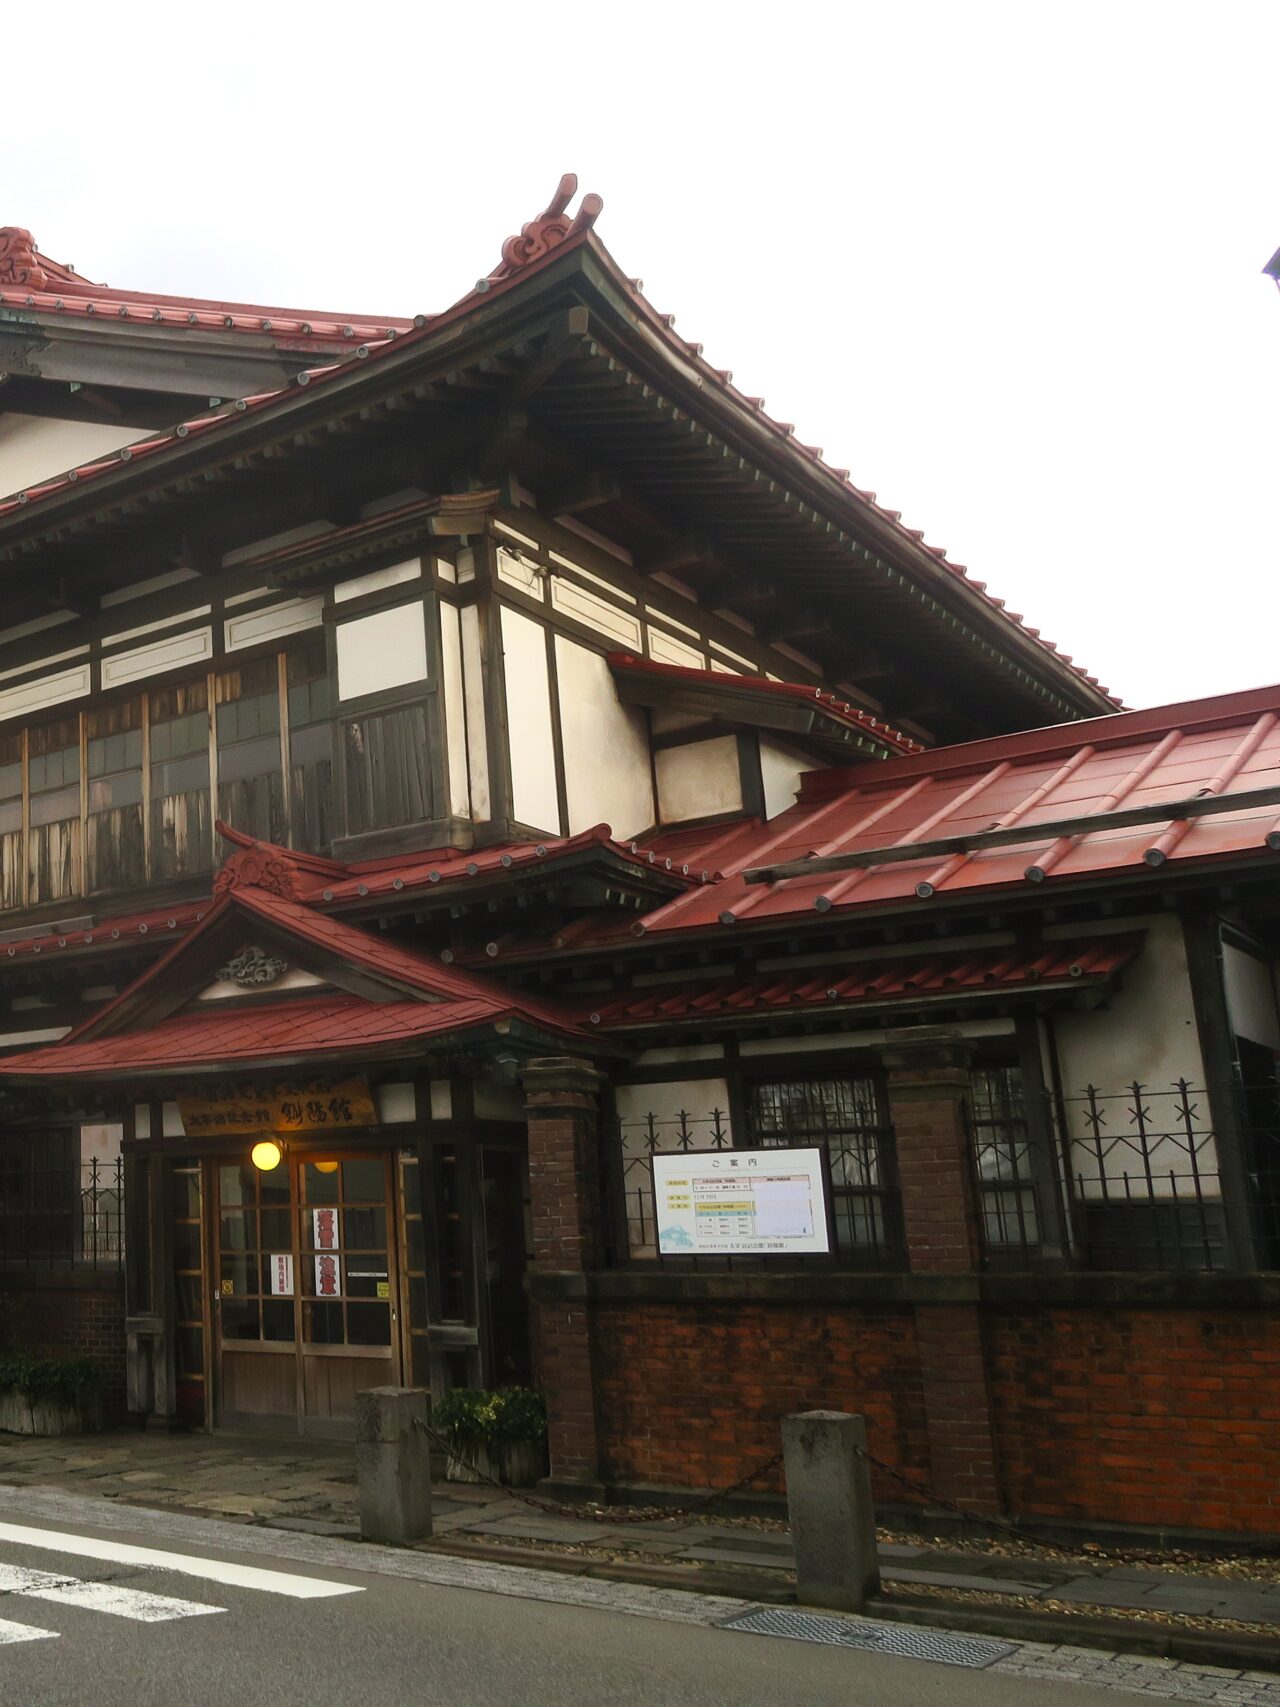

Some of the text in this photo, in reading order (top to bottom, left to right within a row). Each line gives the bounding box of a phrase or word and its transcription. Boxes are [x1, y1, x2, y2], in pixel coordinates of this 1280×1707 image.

[281, 1096, 354, 1127] 斜陽館
[712, 1158, 758, 1168] ご案内
[319, 1256, 336, 1294] 注意
